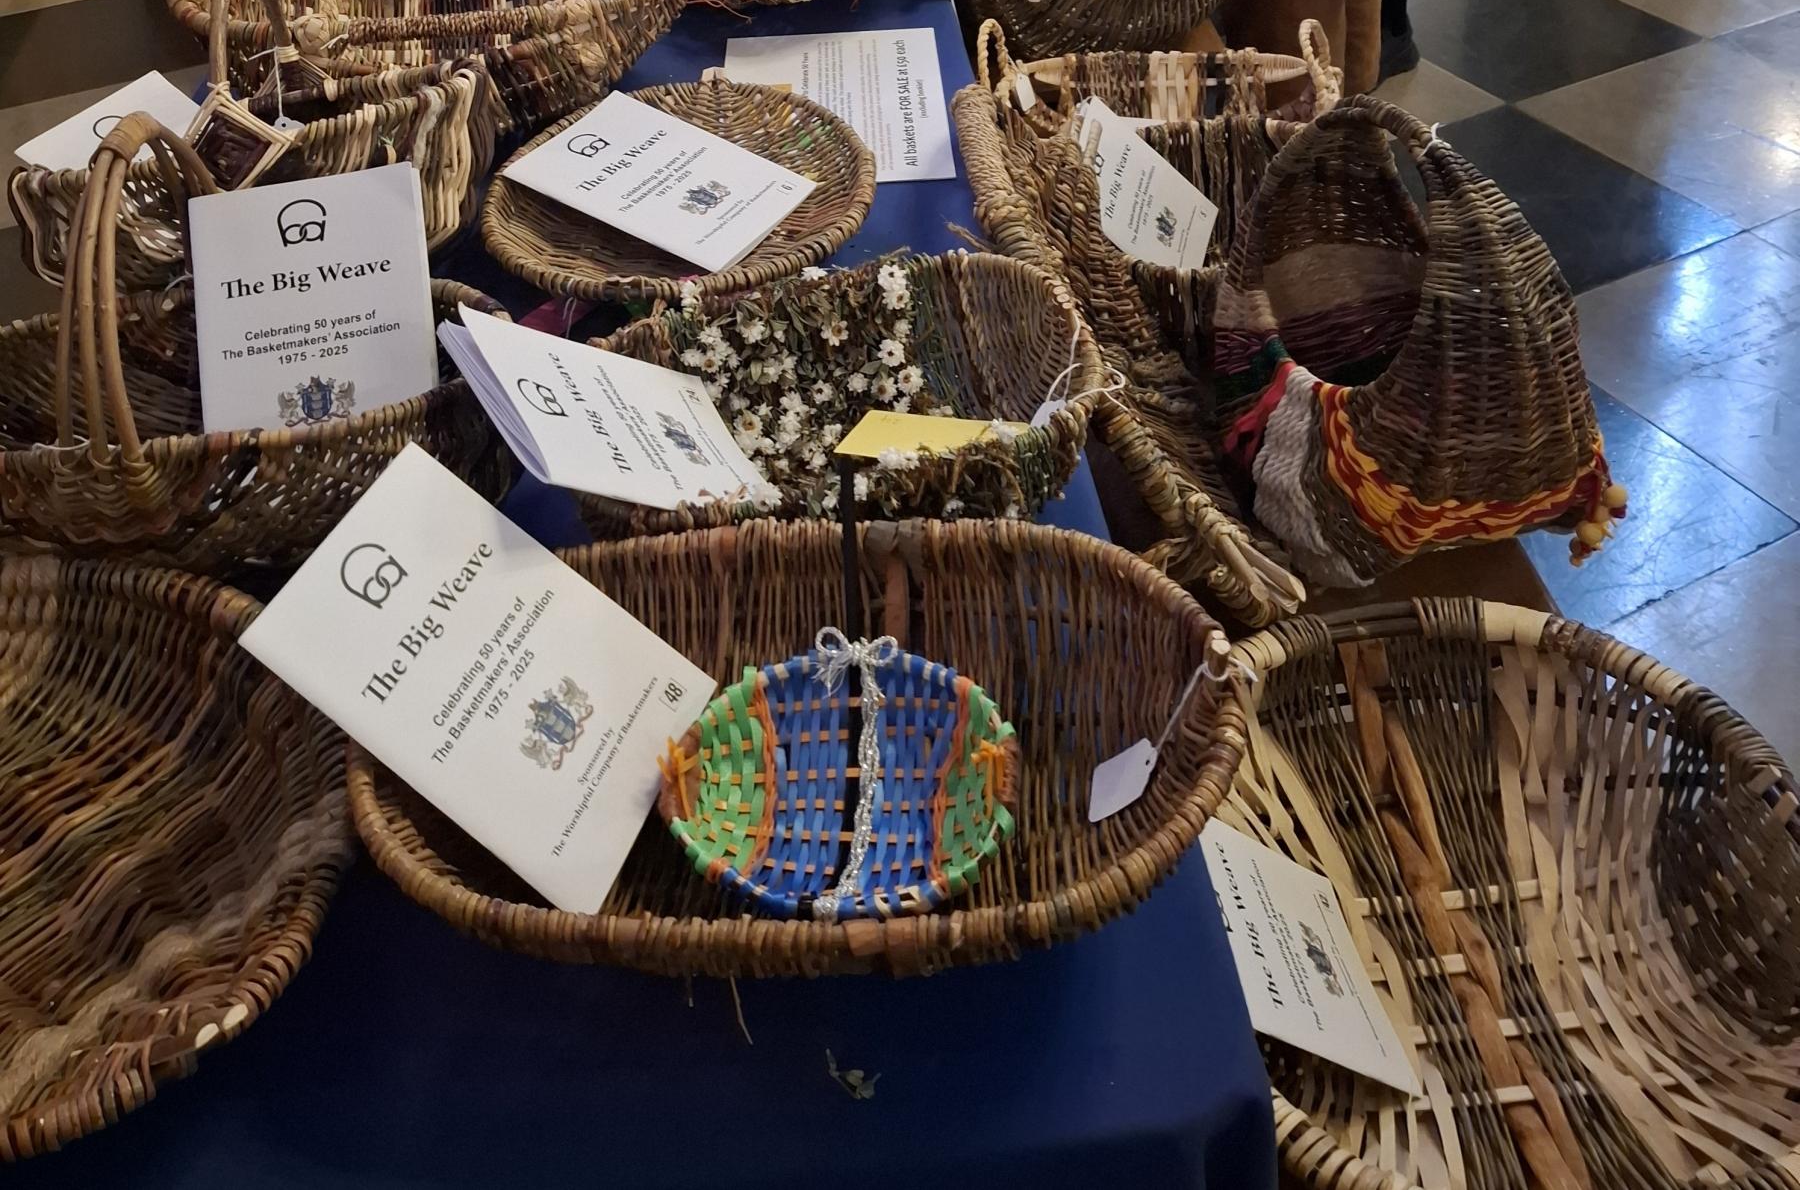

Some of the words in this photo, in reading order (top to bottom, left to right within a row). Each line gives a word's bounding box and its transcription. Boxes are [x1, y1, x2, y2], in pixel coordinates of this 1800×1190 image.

[894, 40, 906, 55] each
[897, 77, 910, 94] SALE
[899, 96, 912, 110] FOR
[903, 112, 914, 123] are
[902, 125, 917, 154] baskets
[576, 176, 606, 191] The
[602, 160, 632, 175] Big
[623, 130, 667, 157] Weave
[621, 175, 658, 200] Celebrating
[663, 157, 680, 170] years
[904, 156, 918, 166] All
[1114, 144, 1131, 177] Weave
[618, 204, 634, 212] The
[673, 147, 708, 173] Association
[656, 186, 673, 197] 1975
[674, 171, 692, 183] 2025
[1110, 181, 1122, 198] Big
[1104, 200, 1115, 219] The
[221, 279, 264, 298] The
[272, 272, 311, 292] Big
[317, 260, 390, 282] Weave
[222, 350, 243, 360] The
[247, 333, 330, 356] Basketmakers'
[334, 323, 400, 341] Association
[245, 324, 310, 341] Celebrating
[315, 319, 327, 329] 50
[331, 315, 361, 329] years
[365, 310, 376, 320] of
[278, 352, 307, 365] 1975
[320, 345, 348, 358] 2025
[549, 353, 586, 402] Weave
[586, 410, 610, 437] Big
[607, 442, 632, 473] The
[362, 660, 407, 702] The
[398, 616, 444, 658] Big
[430, 544, 492, 611] Weave
[432, 741, 454, 763] The
[448, 652, 508, 740] Basketmakers'
[506, 590, 554, 656] Association
[433, 660, 485, 726] Celebrating
[479, 643, 494, 660] 50
[491, 613, 516, 646] years
[514, 596, 525, 612] of
[485, 689, 508, 720] 1975
[510, 649, 534, 682] 2025
[620, 678, 658, 734] Basketmakers
[578, 738, 607, 785] Sponsored
[603, 728, 615, 738] by
[617, 734, 624, 744] of
[592, 745, 619, 787] Company
[562, 786, 594, 838] Worshipful
[553, 840, 565, 856] The
[1216, 842, 1246, 909] Weave
[1246, 922, 1265, 958] Big
[1263, 967, 1283, 1006] The
